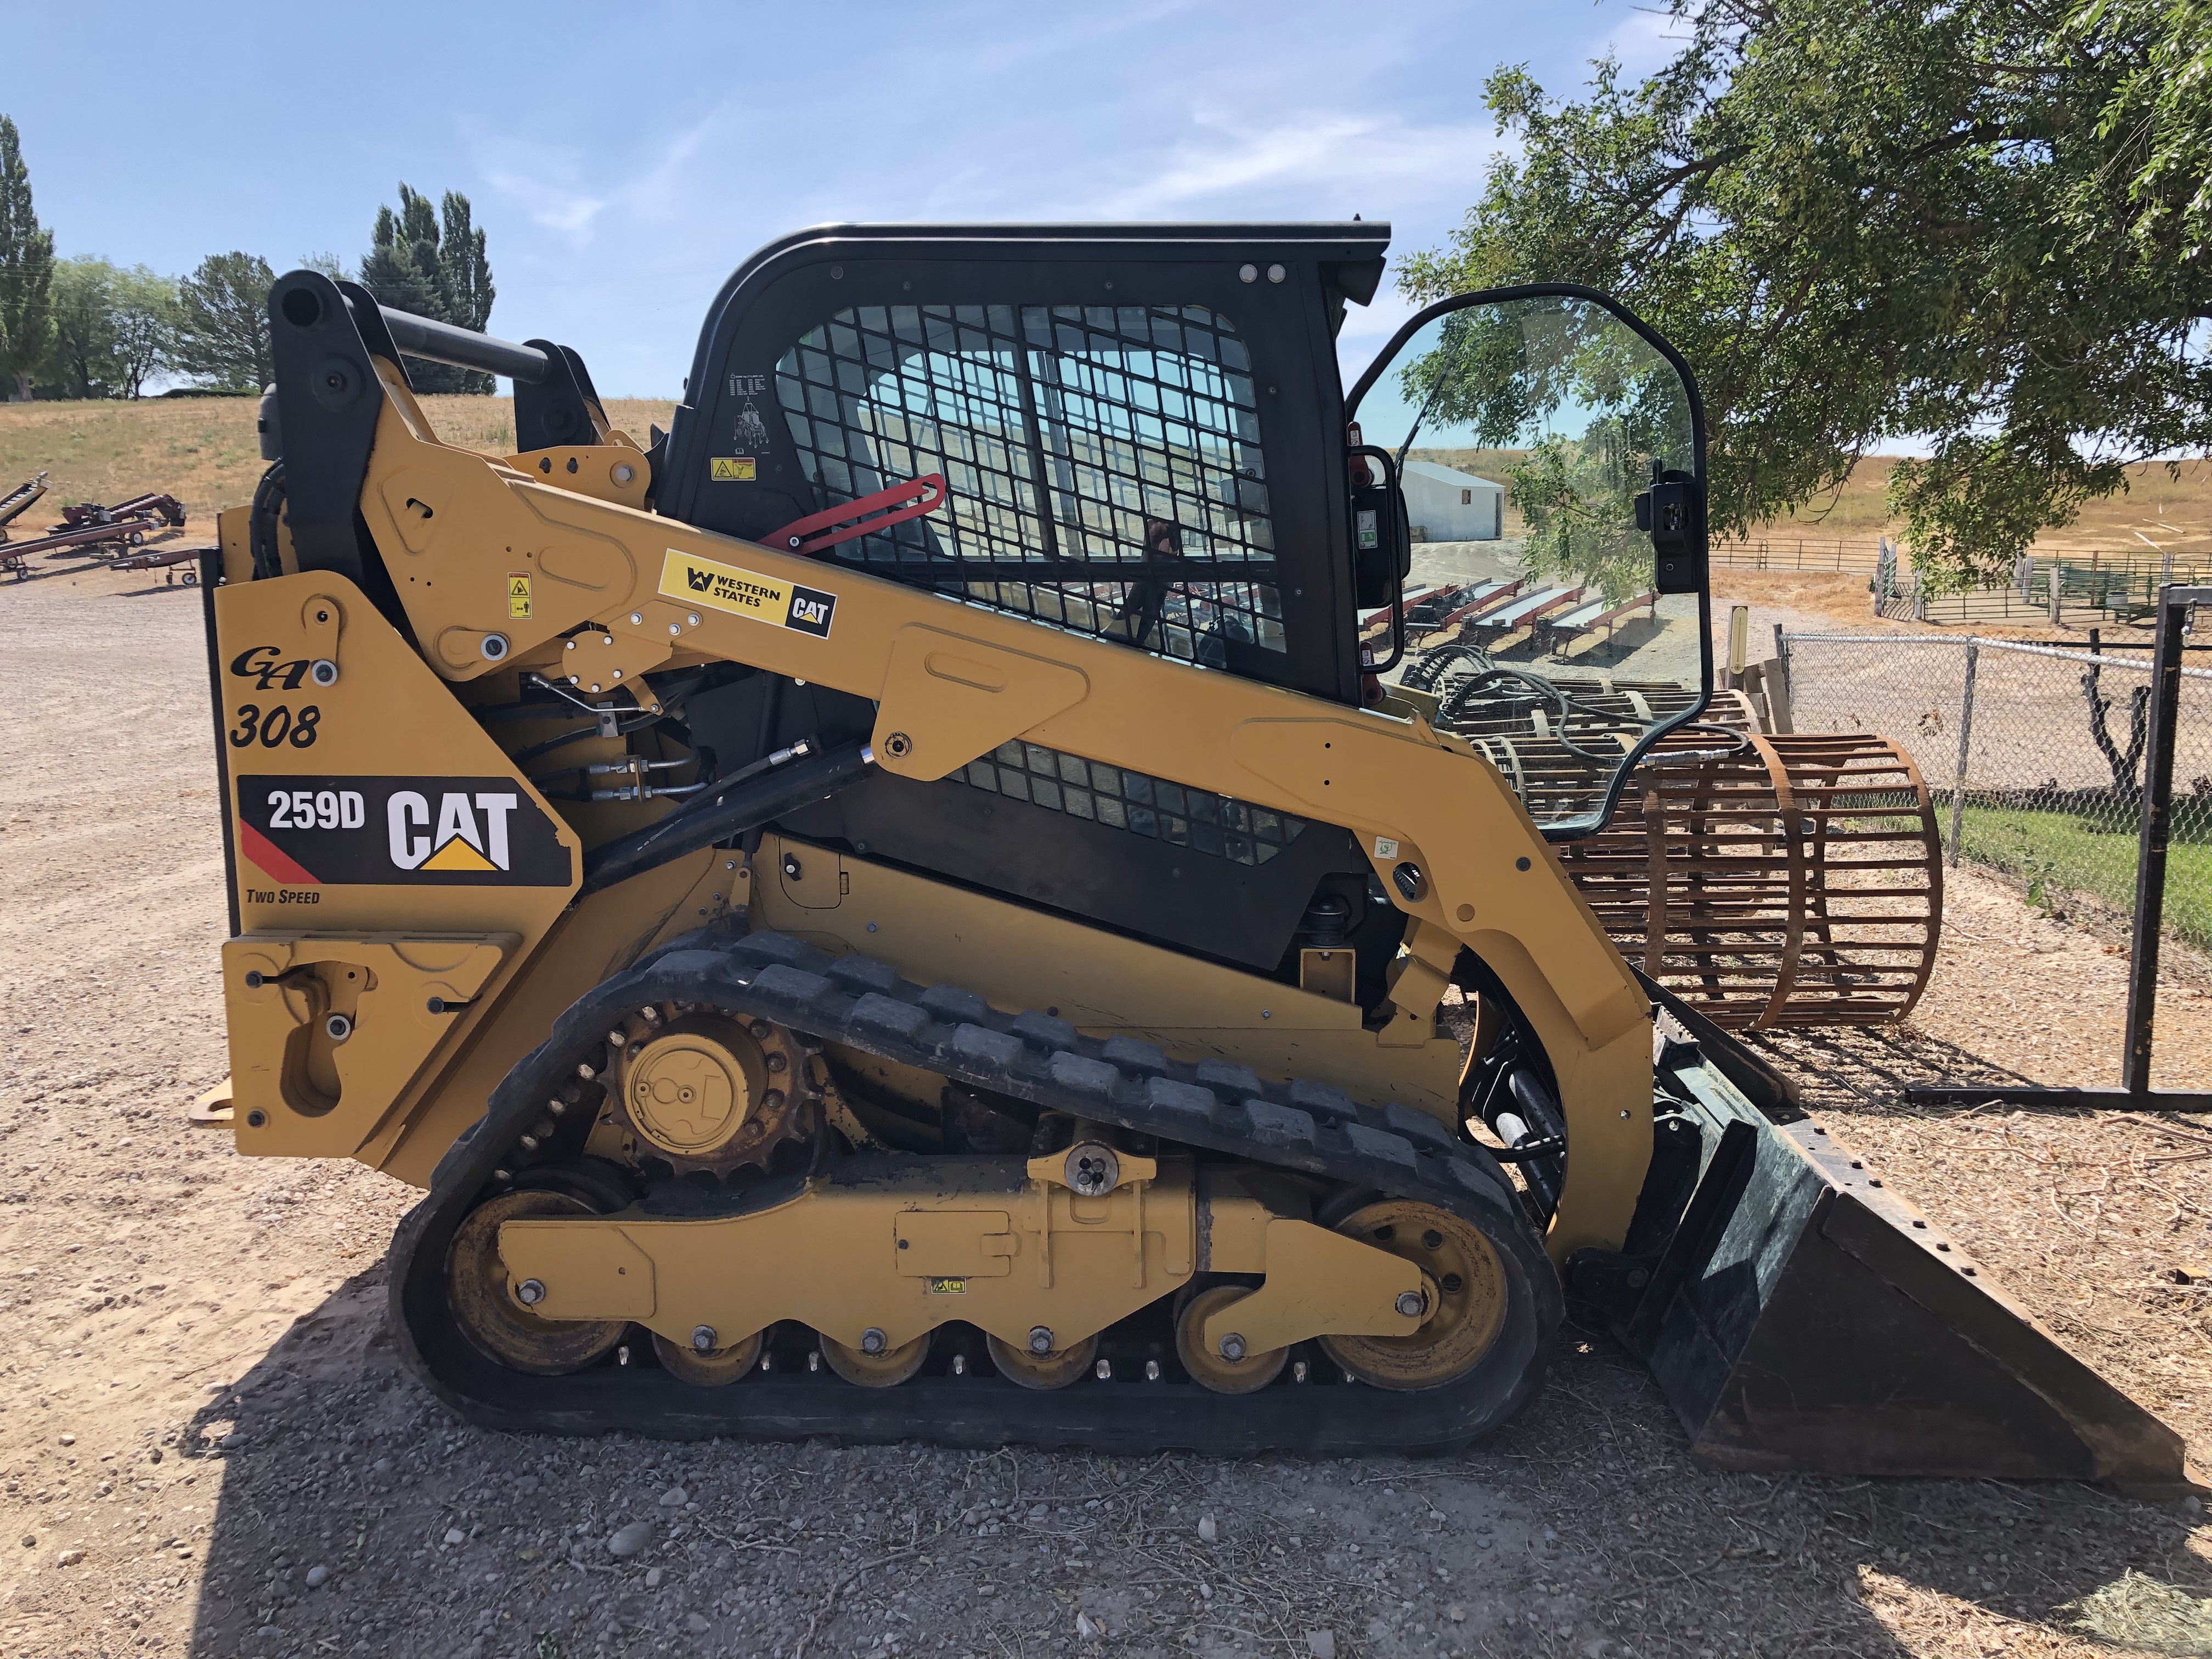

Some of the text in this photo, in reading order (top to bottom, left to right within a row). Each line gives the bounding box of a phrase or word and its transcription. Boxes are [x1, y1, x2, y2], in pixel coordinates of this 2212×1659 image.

[714, 588, 760, 607] STATES
[717, 575, 781, 601] WESTERN
[792, 597, 828, 625] CAT
[230, 646, 309, 690] GA
[229, 704, 320, 748] 308
[268, 790, 517, 870] 259D CAT
[247, 889, 319, 904] TWO SPEED
